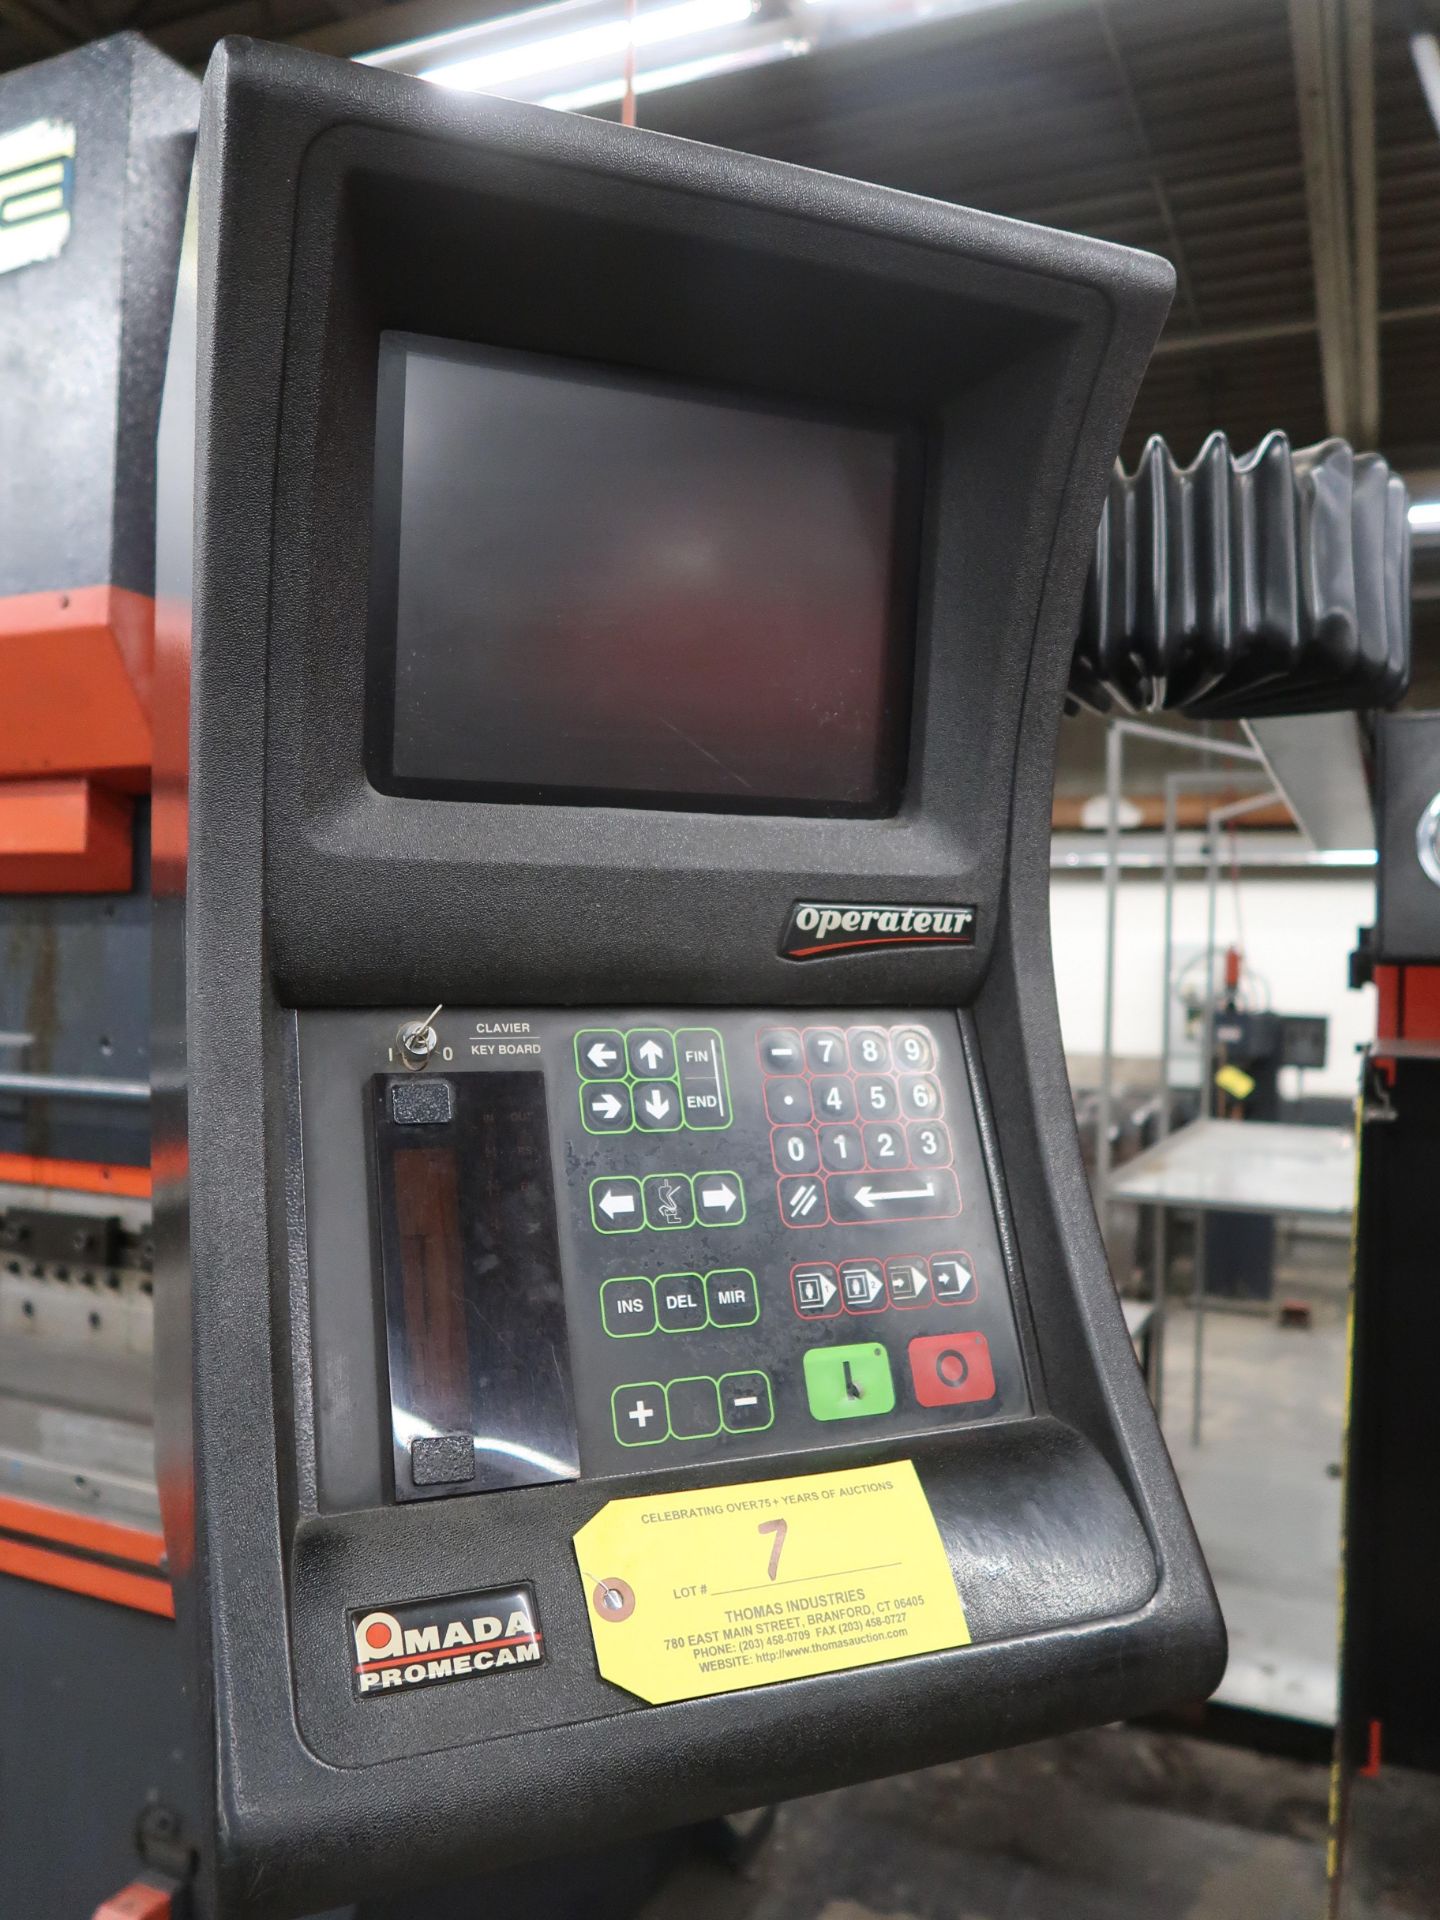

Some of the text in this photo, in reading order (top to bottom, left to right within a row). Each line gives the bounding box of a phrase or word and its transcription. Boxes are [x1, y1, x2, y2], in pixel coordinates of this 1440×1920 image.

[476, 1023, 530, 1033] CLAVIER
[471, 1044, 541, 1055] KEY BOARD
[685, 1050, 708, 1062] FIN
[817, 1040, 833, 1062] 7
[862, 1039, 878, 1062] 8
[904, 1038, 920, 1061] 9
[686, 1095, 717, 1108] END
[826, 1084, 928, 1110] 4 5 6
[787, 1131, 937, 1161] 0 1 2 3
[617, 1290, 746, 1314] INS DEL MIR
[641, 1504, 724, 1524] CELEBRATING
[781, 1491, 820, 1505] YEARS
[821, 1489, 836, 1499] OF
[839, 1480, 894, 1497] AUCTIONS
[758, 1518, 788, 1581] 7
[673, 1585, 697, 1599] LOT
[724, 1588, 866, 1623] THOMAS INDUSTRIES
[355, 1611, 536, 1663] AMADA
[664, 1595, 925, 1651] 780 EAST MAIN STREET, BRANFORD, CT 06405
[693, 1612, 907, 1659] PHONE: (203) 458-0709 FAX (203) 458-0727
[699, 1627, 908, 1673] WEBSITE: http://www.thomasauction.com
[360, 1642, 541, 1692] PROMECAM
